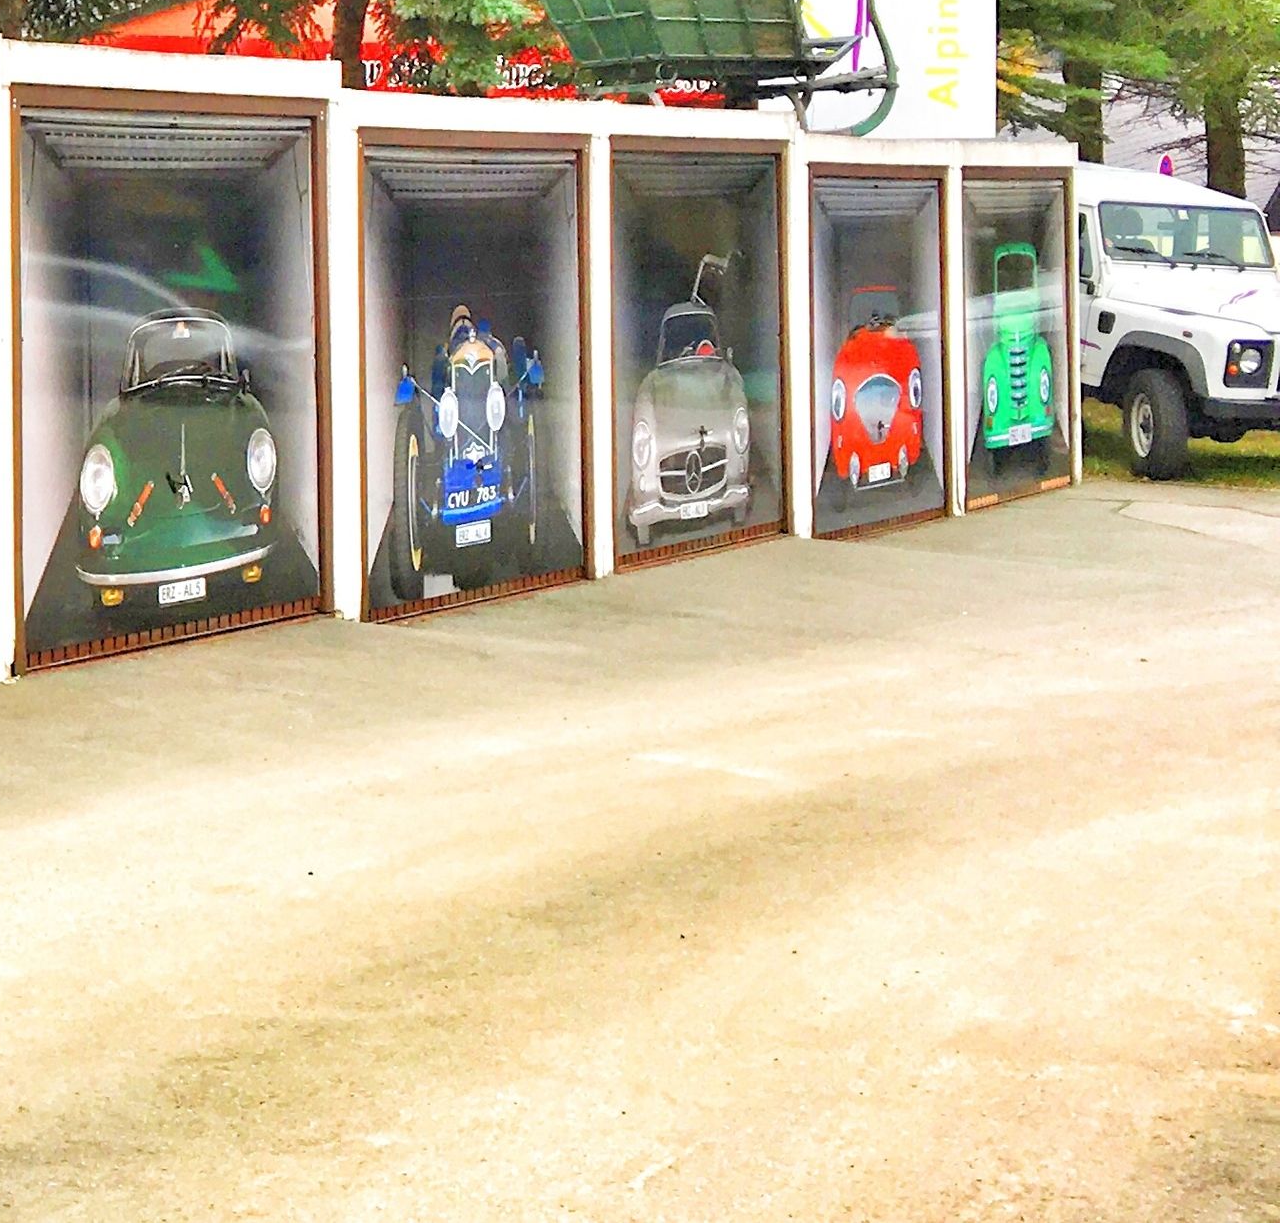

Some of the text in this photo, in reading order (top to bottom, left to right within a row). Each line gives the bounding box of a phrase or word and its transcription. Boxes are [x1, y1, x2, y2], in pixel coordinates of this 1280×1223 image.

[448, 485, 496, 508] CYU 783
[161, 586, 176, 601] ERZ
[183, 583, 194, 597] AL
